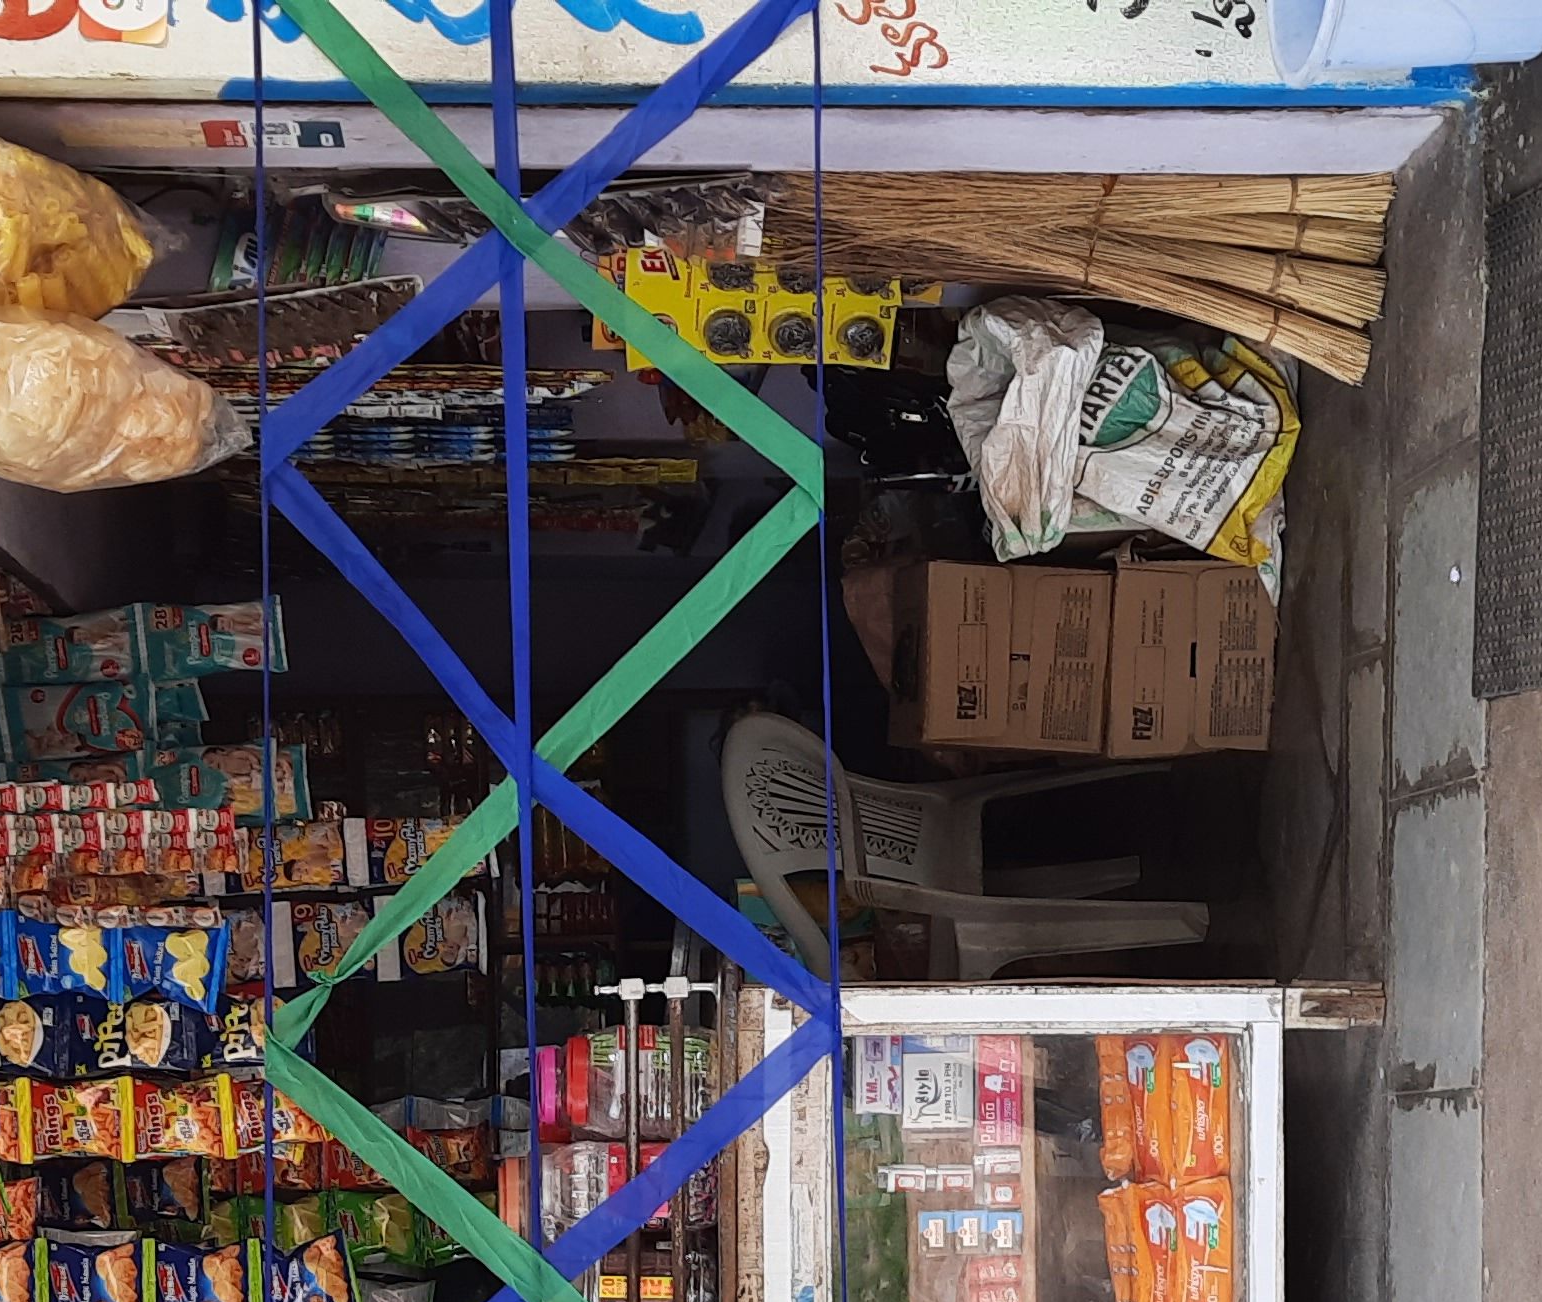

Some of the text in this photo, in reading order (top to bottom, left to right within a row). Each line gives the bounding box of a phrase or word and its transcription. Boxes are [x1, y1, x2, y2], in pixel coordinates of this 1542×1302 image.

[1135, 479, 1161, 516] ABIS
[10, 623, 23, 643] 28
[154, 609, 168, 629] 28
[43, 633, 60, 679] Pampers
[186, 619, 203, 666] Pampers
[956, 685, 978, 720] FIZZ
[1131, 706, 1154, 740] FIZZ
[373, 819, 394, 837] 10
[294, 904, 312, 919] 9
[44, 1095, 60, 1146] Rings
[146, 1094, 163, 1145] Rings
[242, 1090, 264, 1138] Rings
[1132, 1103, 1147, 1145] whisper
[1193, 1095, 1211, 1141] whisper
[601, 1278, 615, 1296] 20
[1186, 1257, 1204, 1301] whisper
